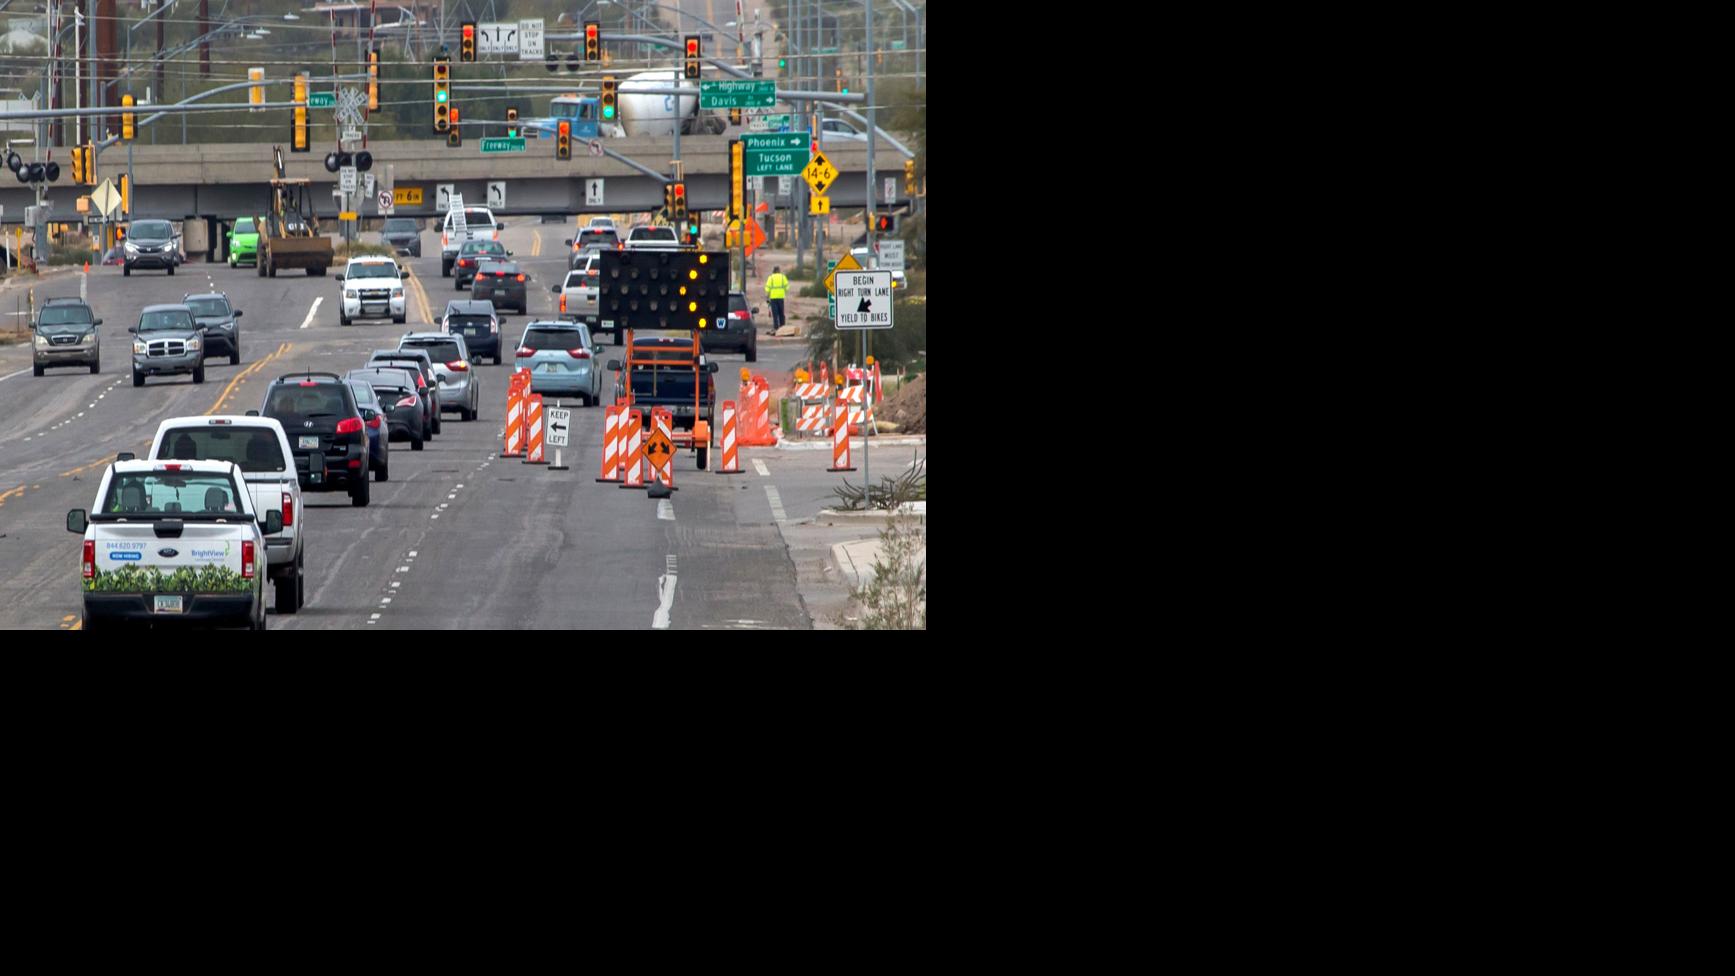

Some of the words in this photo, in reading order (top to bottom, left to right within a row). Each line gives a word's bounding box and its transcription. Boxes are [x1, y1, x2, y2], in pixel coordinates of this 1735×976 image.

[719, 82, 755, 93] Highway
[711, 96, 736, 106] Davis
[482, 141, 511, 151] Freeway
[748, 138, 785, 147] Phoenix
[759, 153, 792, 162] Tucson
[775, 163, 793, 171] LANE
[807, 168, 831, 179] 14-6
[407, 191, 413, 201] 6
[853, 276, 874, 285] BEGIN
[838, 288, 854, 297] RIGHT
[858, 288, 872, 296] TURN
[875, 288, 889, 296] LANE
[841, 314, 859, 324] YIELD
[861, 314, 868, 322] TO
[871, 313, 888, 322] BIKES
[550, 410, 569, 419] KEEP
[549, 435, 566, 444] LEFT
[192, 549, 224, 558] BrightView
